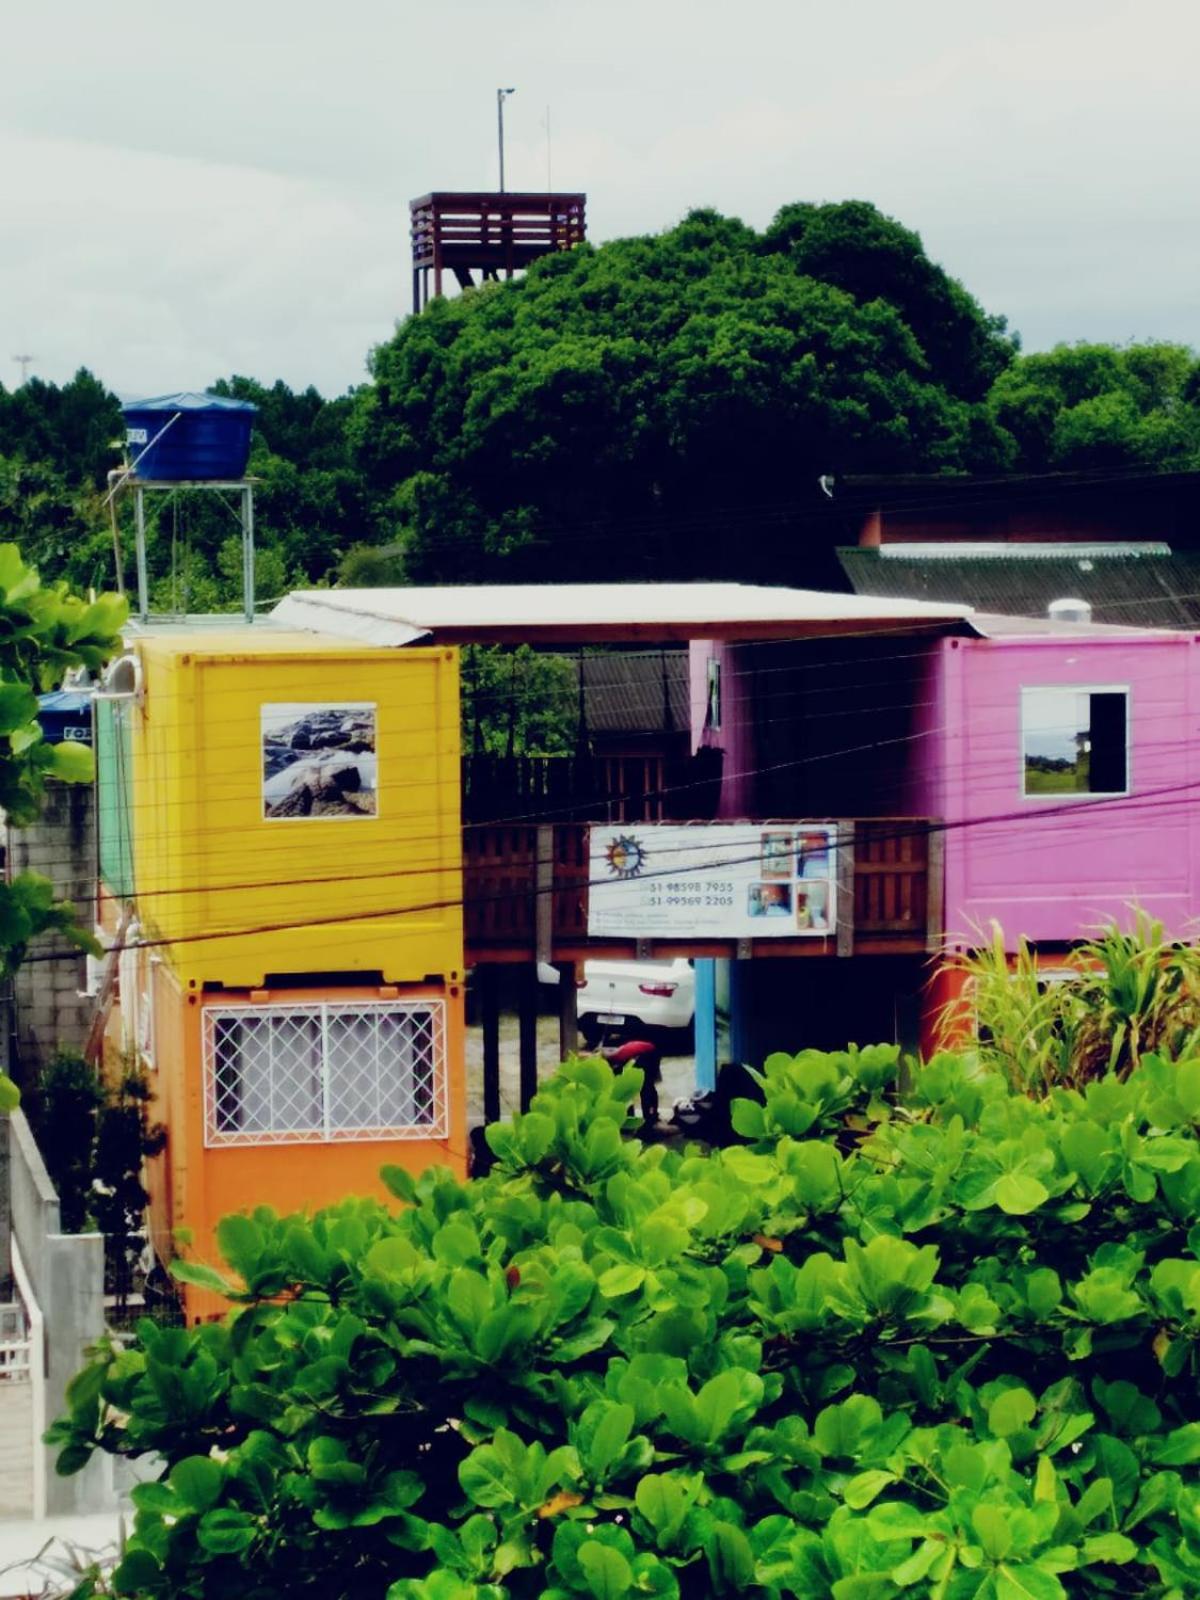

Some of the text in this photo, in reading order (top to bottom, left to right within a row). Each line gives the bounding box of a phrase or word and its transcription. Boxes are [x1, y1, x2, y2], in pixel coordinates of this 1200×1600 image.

[650, 883, 662, 893] 51
[650, 896, 662, 906] 51
[706, 896, 733, 906] 2205
